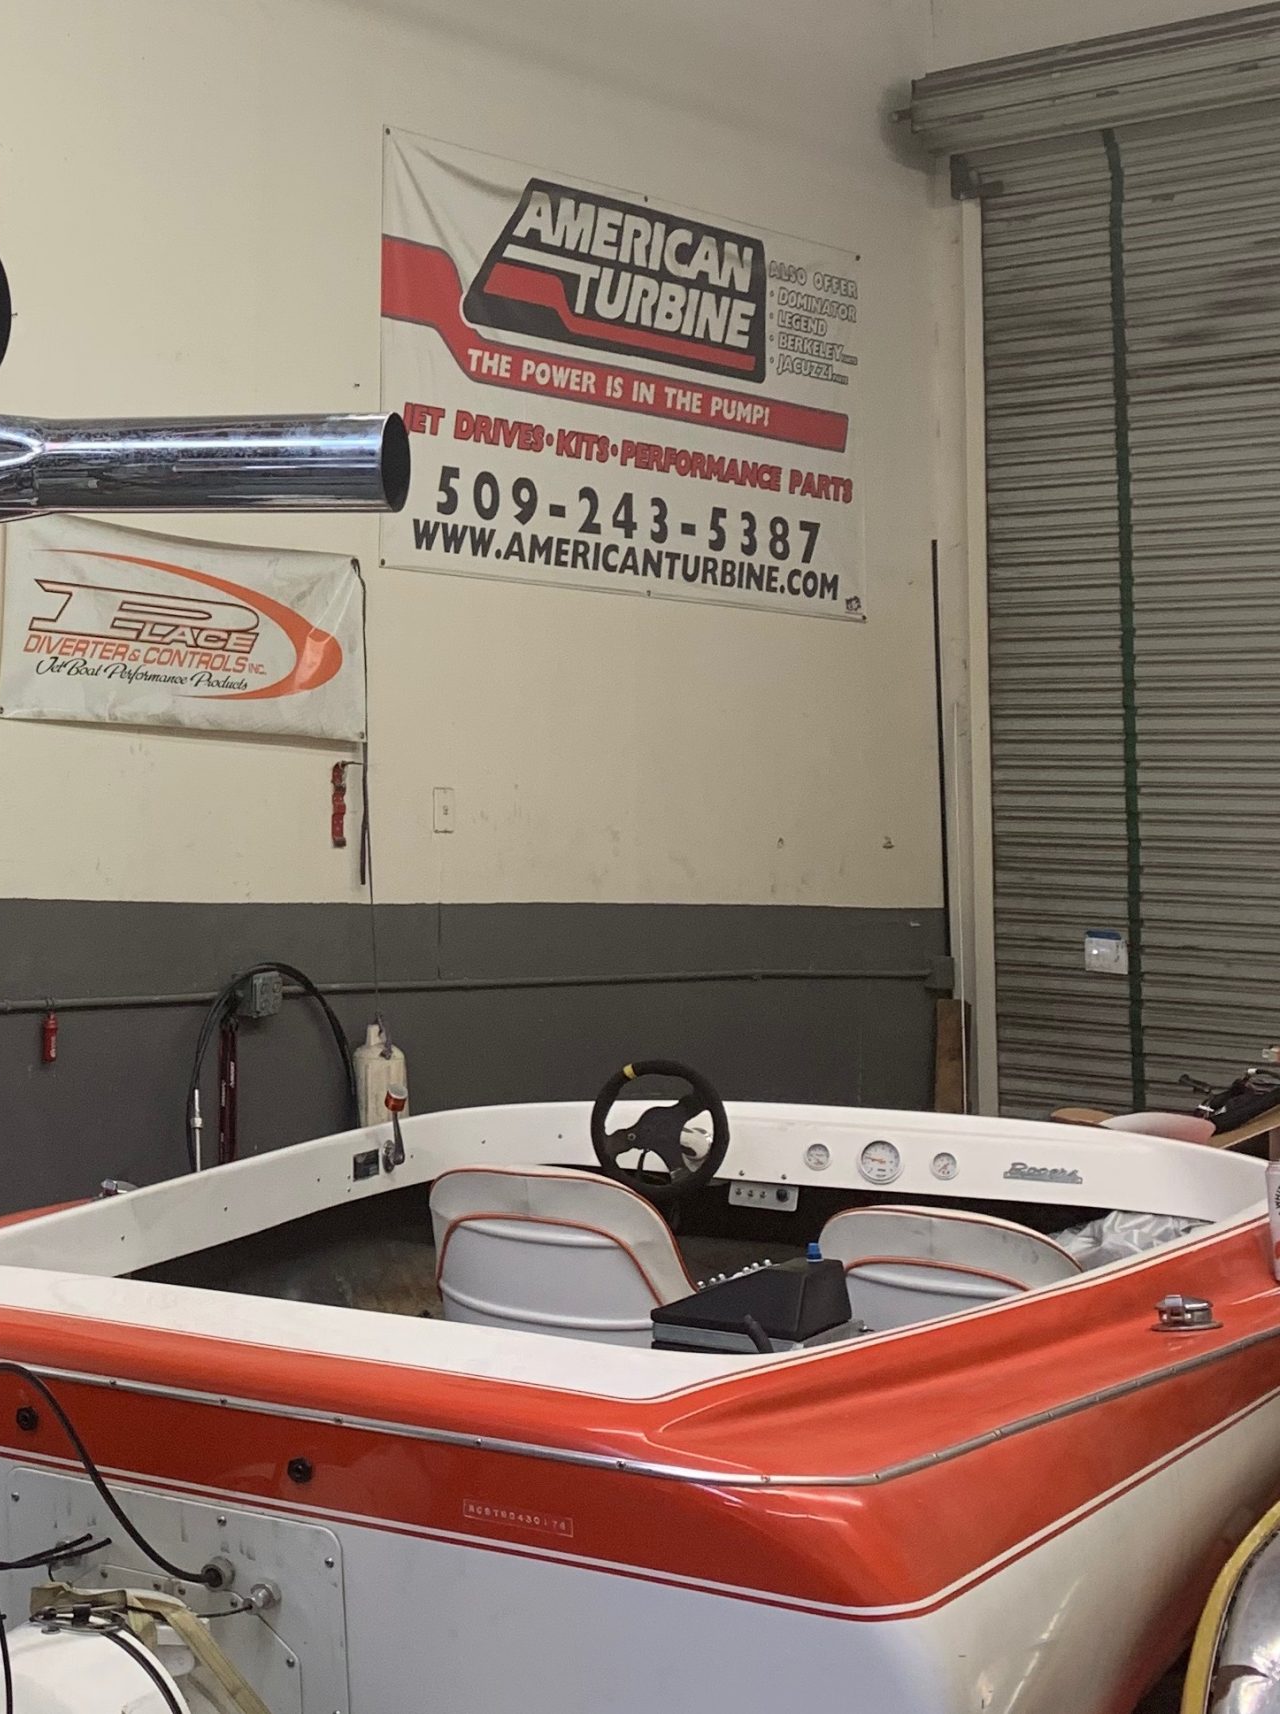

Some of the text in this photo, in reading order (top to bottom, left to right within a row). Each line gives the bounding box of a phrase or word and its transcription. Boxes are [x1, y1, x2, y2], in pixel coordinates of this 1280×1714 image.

[513, 190, 753, 293] AMERICAN
[503, 244, 757, 348] TURBINE
[769, 260, 858, 299] ALSO OFFER
[778, 287, 857, 323] DOMINATOR
[778, 309, 827, 337] LEGEND
[778, 332, 844, 362] BERKELEY
[777, 354, 833, 381] JACUZZI
[468, 348, 770, 427] THE POWER IS IN THE PUMP!
[788, 468, 854, 504] PARTS
[436, 465, 821, 564] 509-243-5387
[412, 517, 840, 602] WWW.AMERICANTURBINE.COM
[23, 633, 268, 676] DIVERTER & CONTROLS INC.
[36, 656, 249, 691] Jet Boat Performance Products
